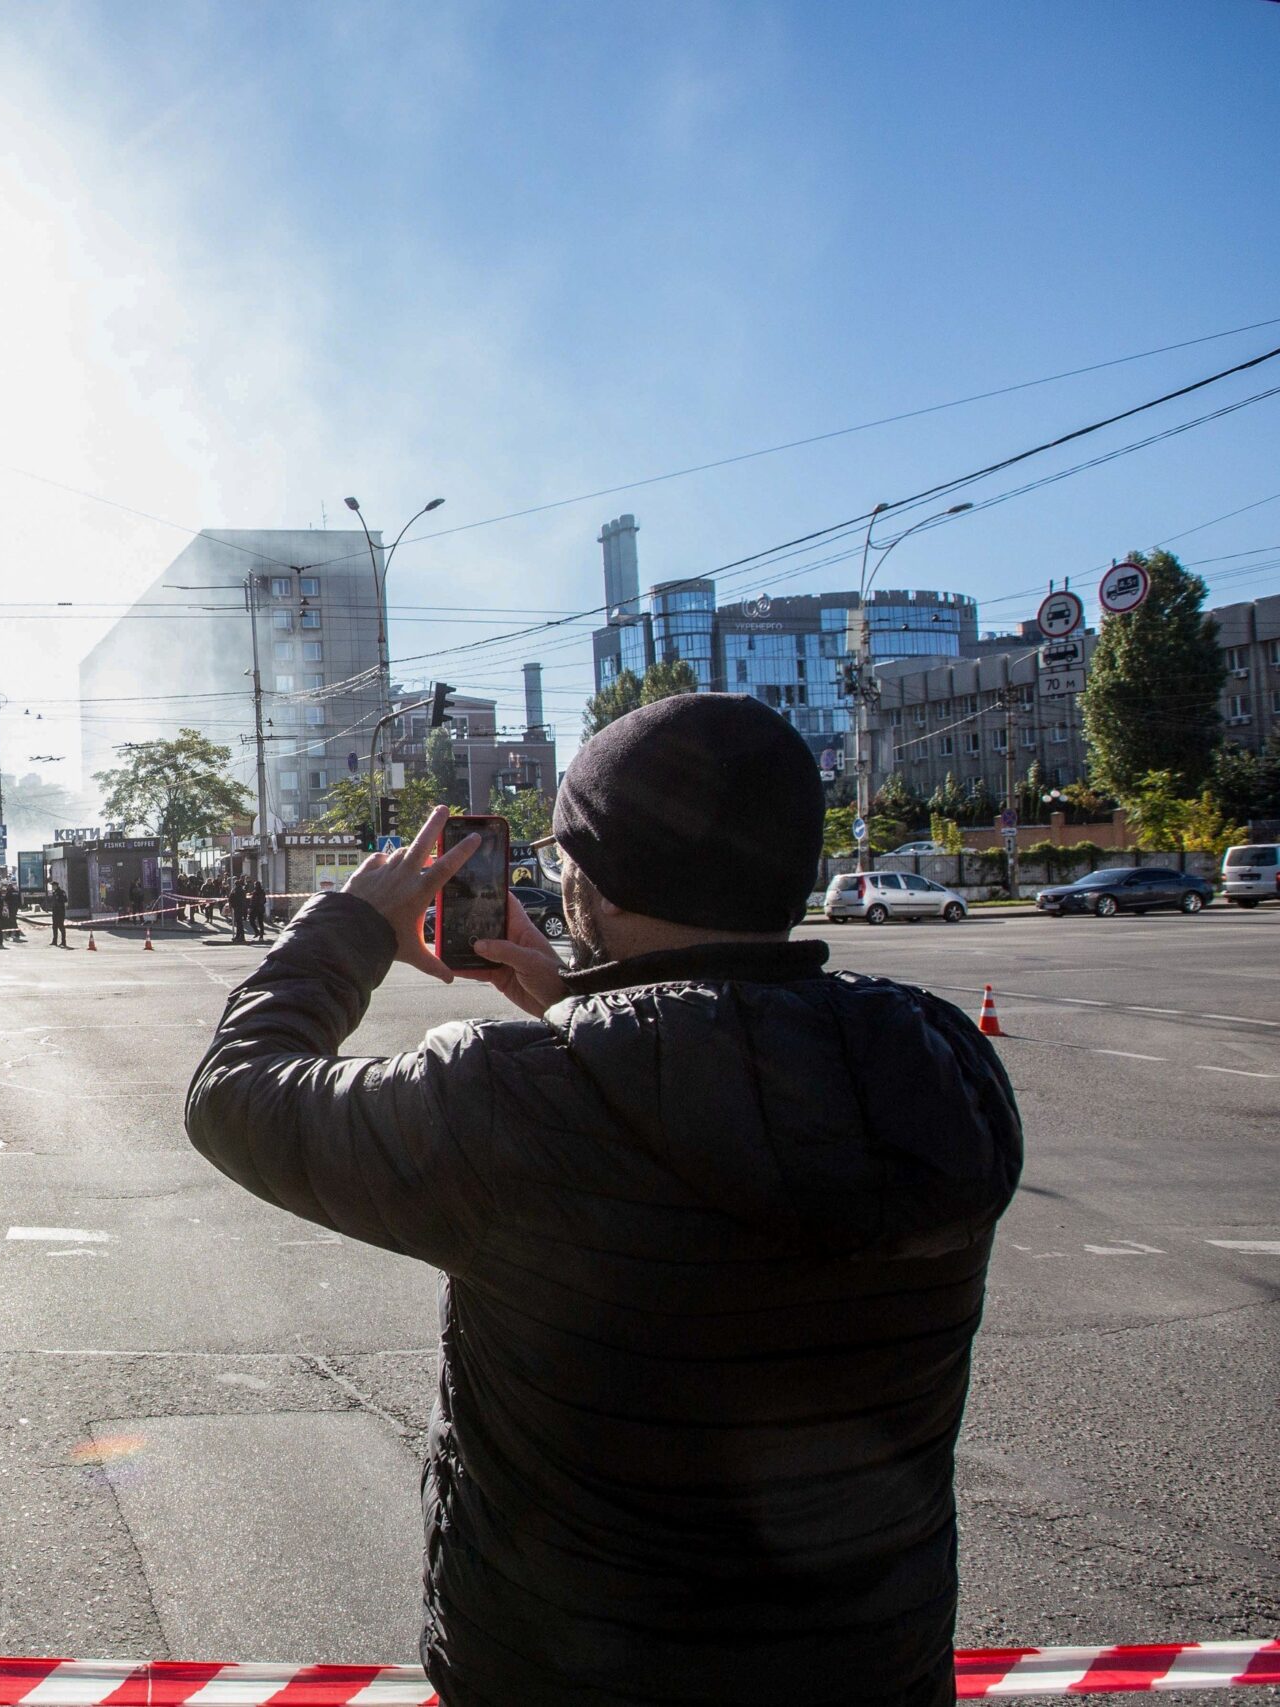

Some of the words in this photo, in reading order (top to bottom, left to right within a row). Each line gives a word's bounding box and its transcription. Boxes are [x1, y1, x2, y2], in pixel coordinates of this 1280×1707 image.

[1045, 678, 1060, 690] 70
[54, 827, 100, 842] КВІТИ
[284, 835, 363, 845] ПЕКАР
